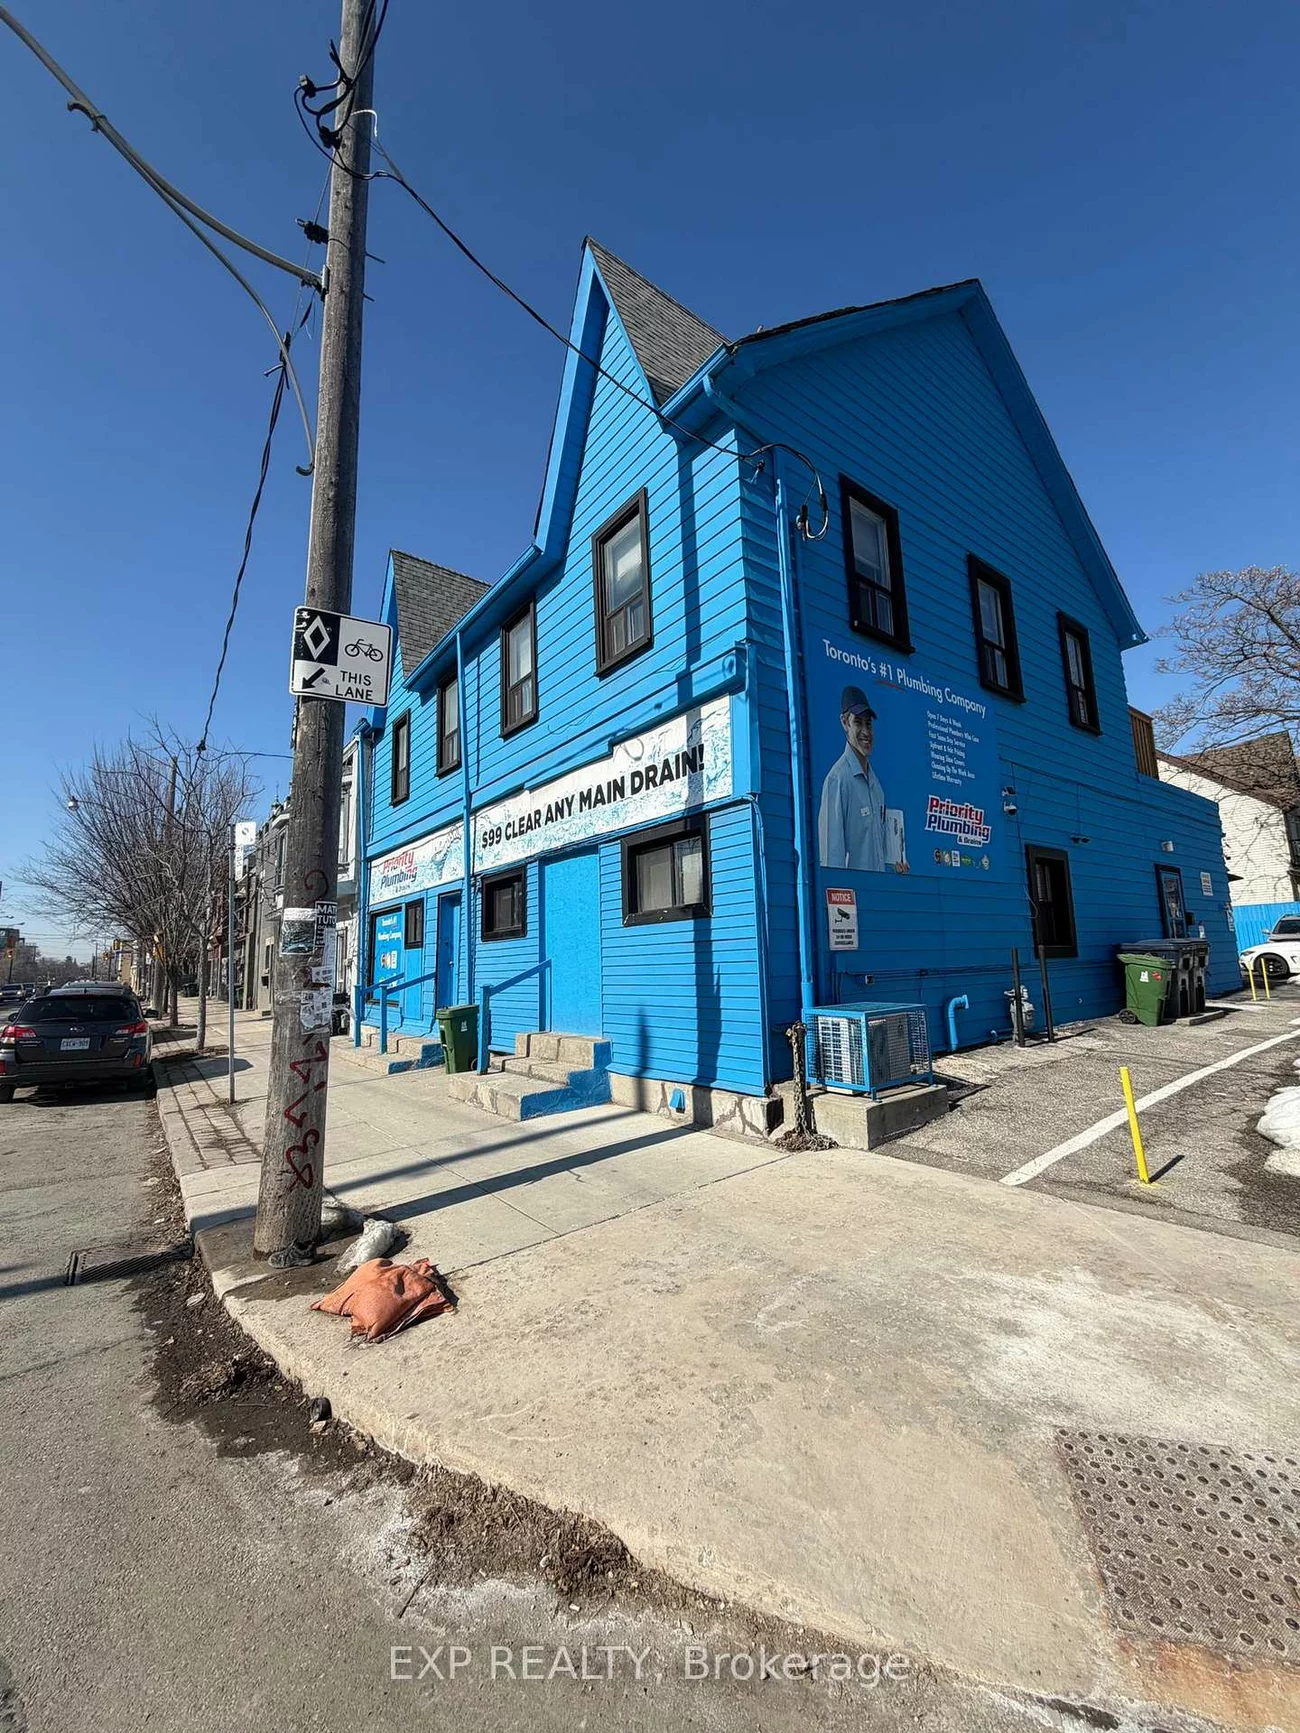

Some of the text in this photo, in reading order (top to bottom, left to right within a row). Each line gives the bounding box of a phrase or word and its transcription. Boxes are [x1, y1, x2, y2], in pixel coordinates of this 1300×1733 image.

[340, 670, 371, 686] THIS
[823, 638, 986, 719] Toronto's #1 Plumbing Company
[336, 684, 373, 701] LANE
[481, 744, 704, 849] $99 CLEAR ANY MAIN DRAIN!
[929, 796, 983, 826] Priority
[926, 814, 990, 842] Plumbing
[383, 851, 415, 875] Priority
[380, 868, 418, 890] Plumbing
[831, 892, 852, 902] NOTICE
